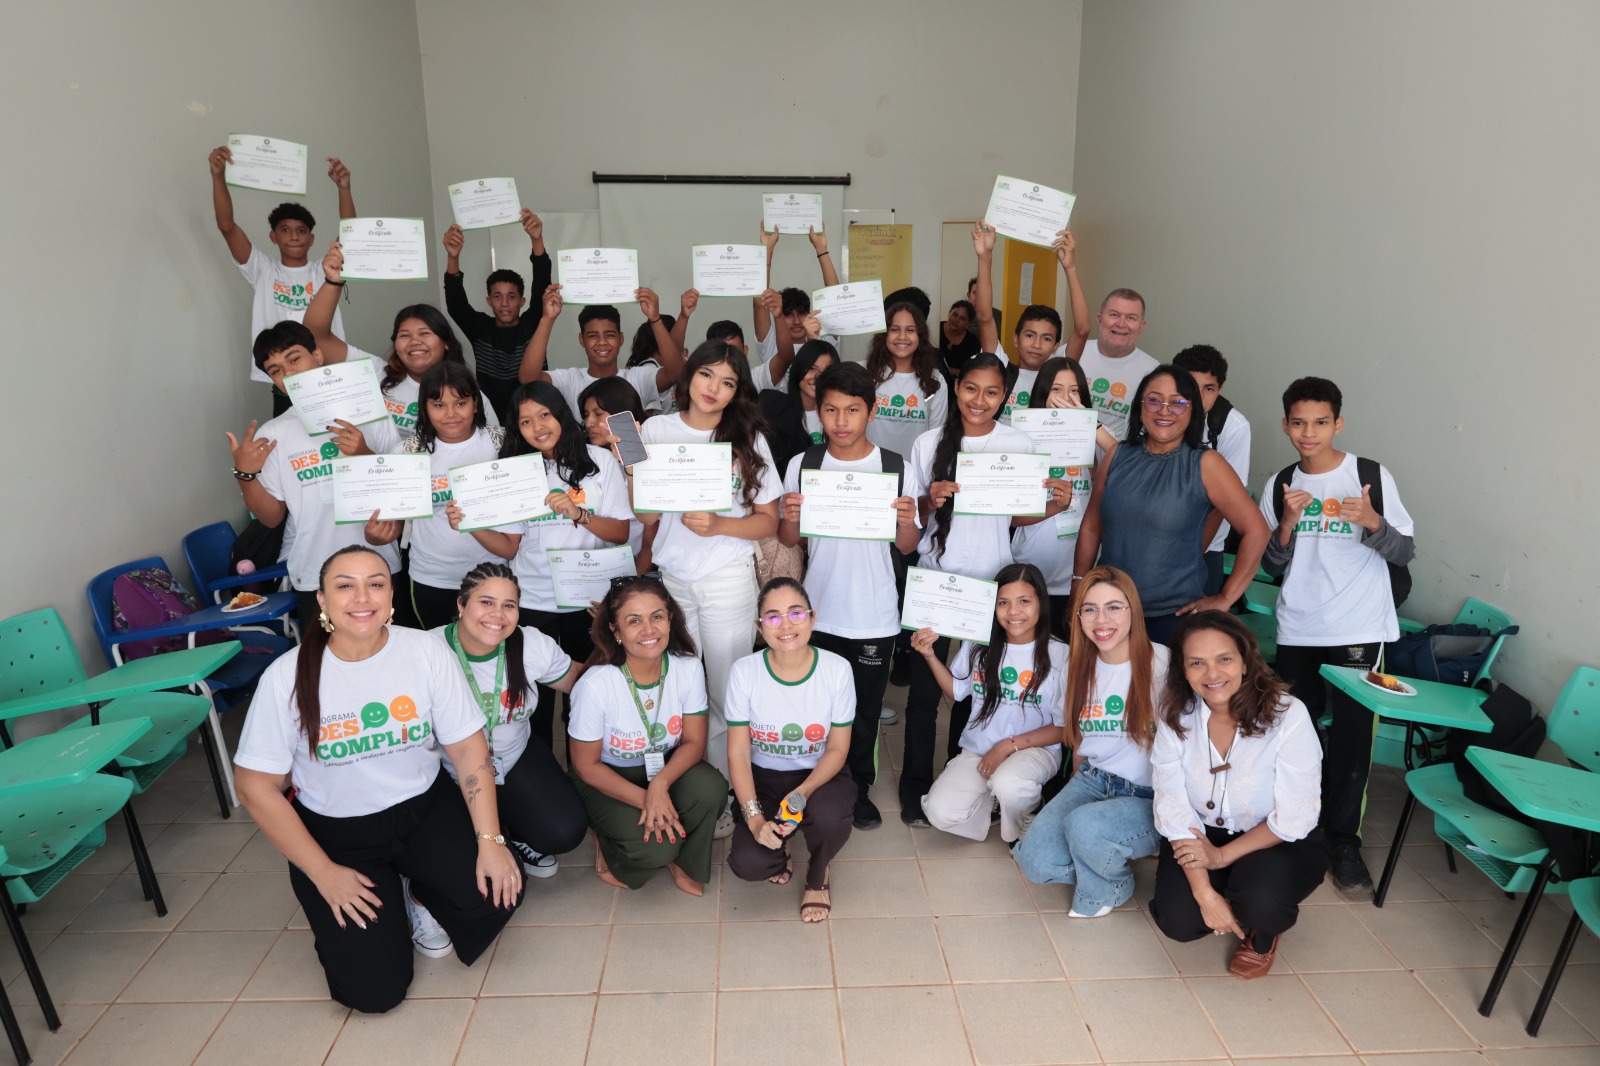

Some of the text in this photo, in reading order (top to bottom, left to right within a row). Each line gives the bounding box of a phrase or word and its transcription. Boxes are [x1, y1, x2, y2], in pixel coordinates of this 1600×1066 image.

[1091, 394, 1130, 414] PLICA
[290, 453, 319, 471] DES
[1294, 518, 1353, 533] MPLICA
[320, 712, 356, 724] OGRAMA
[319, 719, 360, 742] DES
[611, 728, 642, 738] PROJETO
[316, 721, 431, 760] COMPLICA
[609, 734, 646, 750] DES
